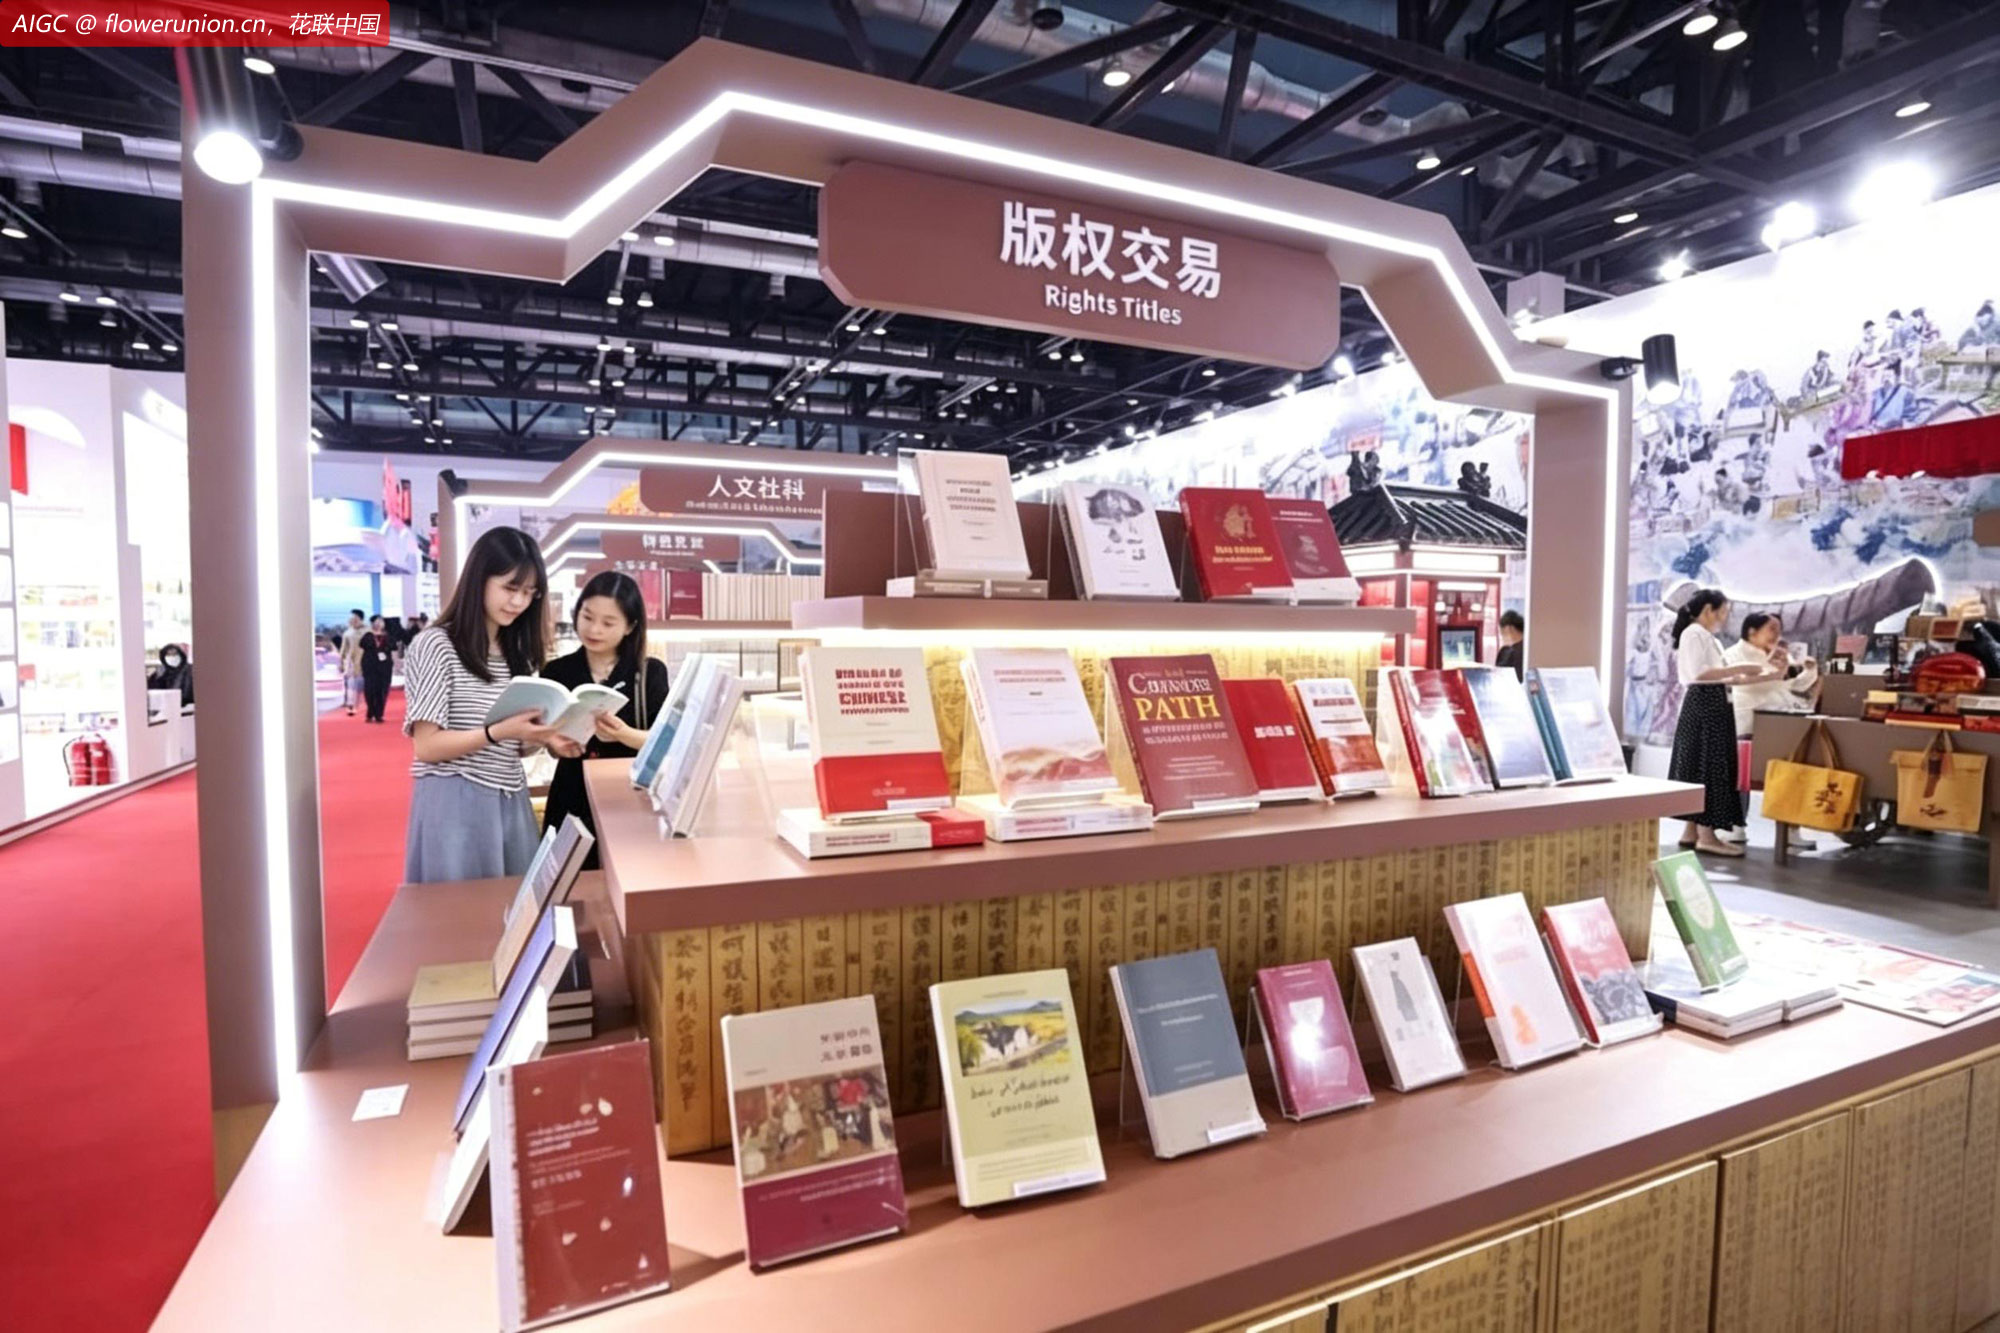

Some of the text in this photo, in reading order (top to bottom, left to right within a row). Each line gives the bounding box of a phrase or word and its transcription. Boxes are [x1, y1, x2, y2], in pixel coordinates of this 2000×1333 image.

[1000, 201, 1221, 298] 版权交易
[1045, 284, 1182, 325] Rights Titles
[707, 474, 805, 501] 人文社科
[1133, 694, 1221, 721] PATH
